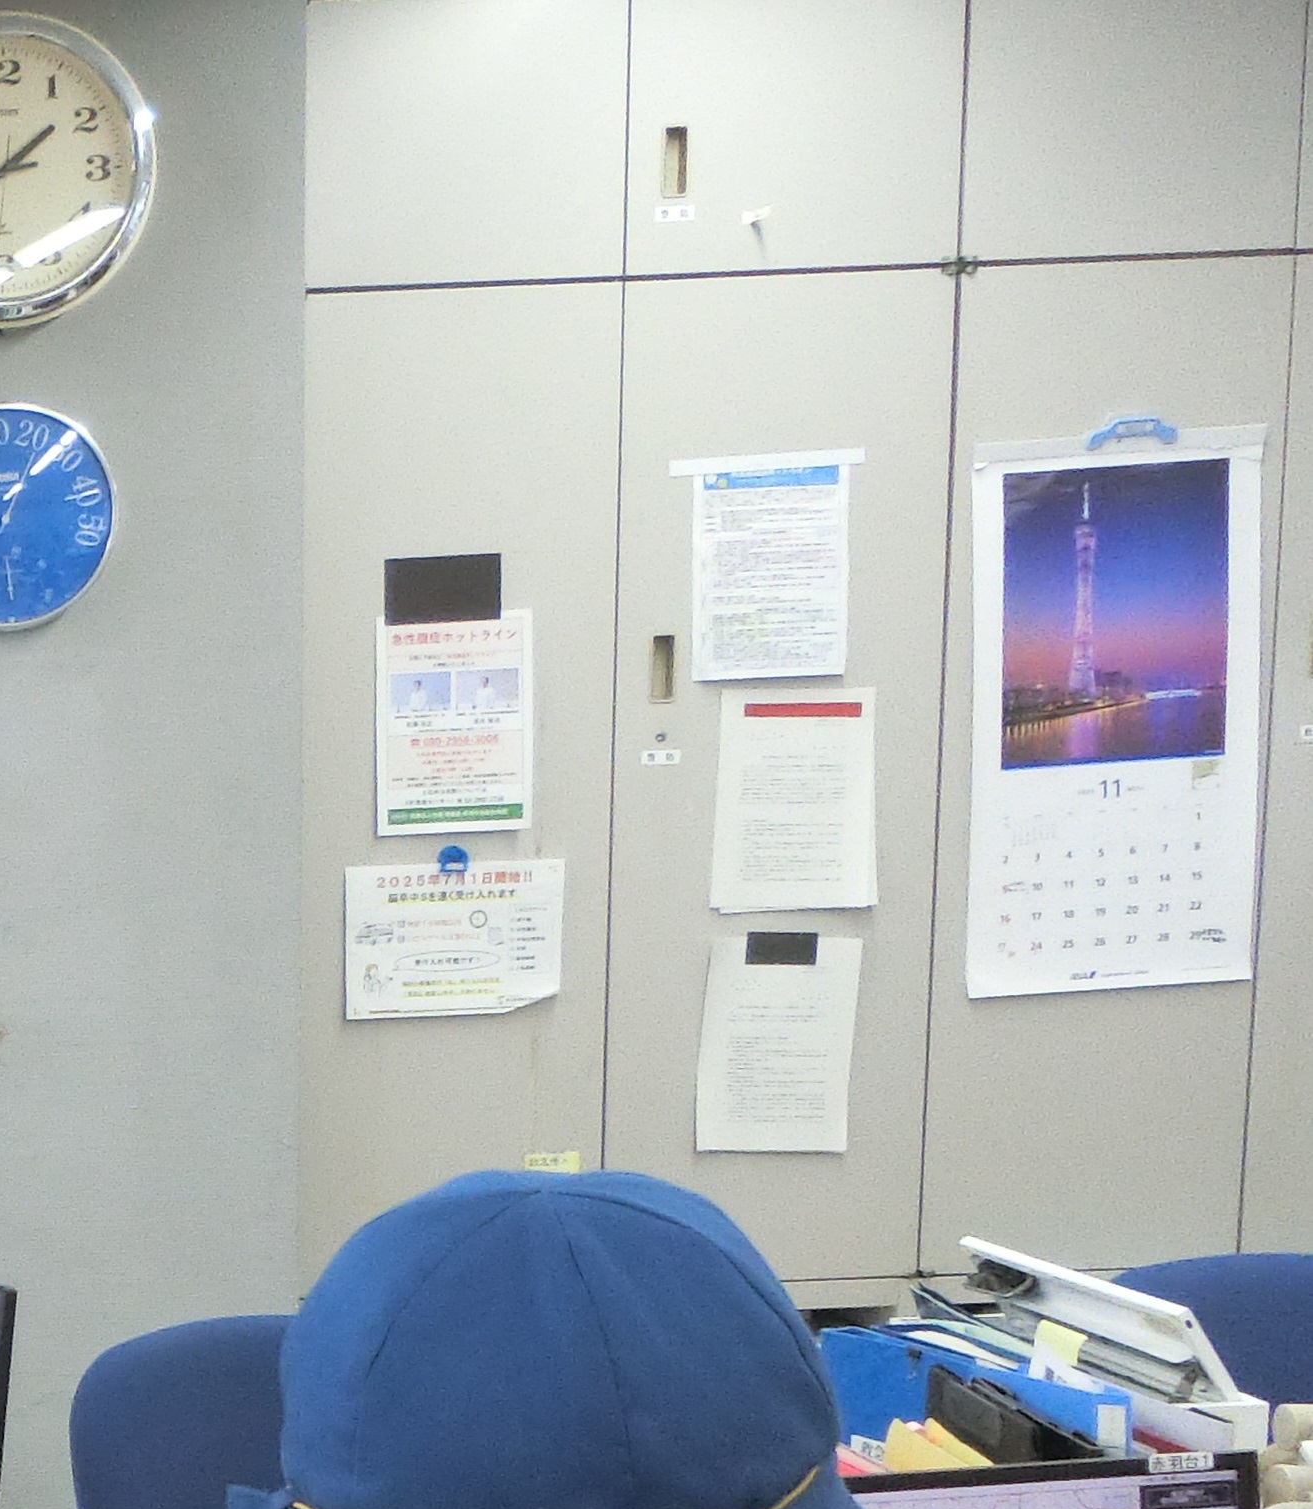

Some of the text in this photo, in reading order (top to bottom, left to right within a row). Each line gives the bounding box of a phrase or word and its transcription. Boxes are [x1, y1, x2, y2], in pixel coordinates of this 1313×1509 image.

[47, 75, 58, 100] 1
[74, 107, 98, 133] 2
[86, 154, 111, 182] 3
[13, 419, 50, 451] 20
[72, 475, 103, 508] 40
[75, 513, 107, 547] 50
[1099, 779, 1120, 799] 11
